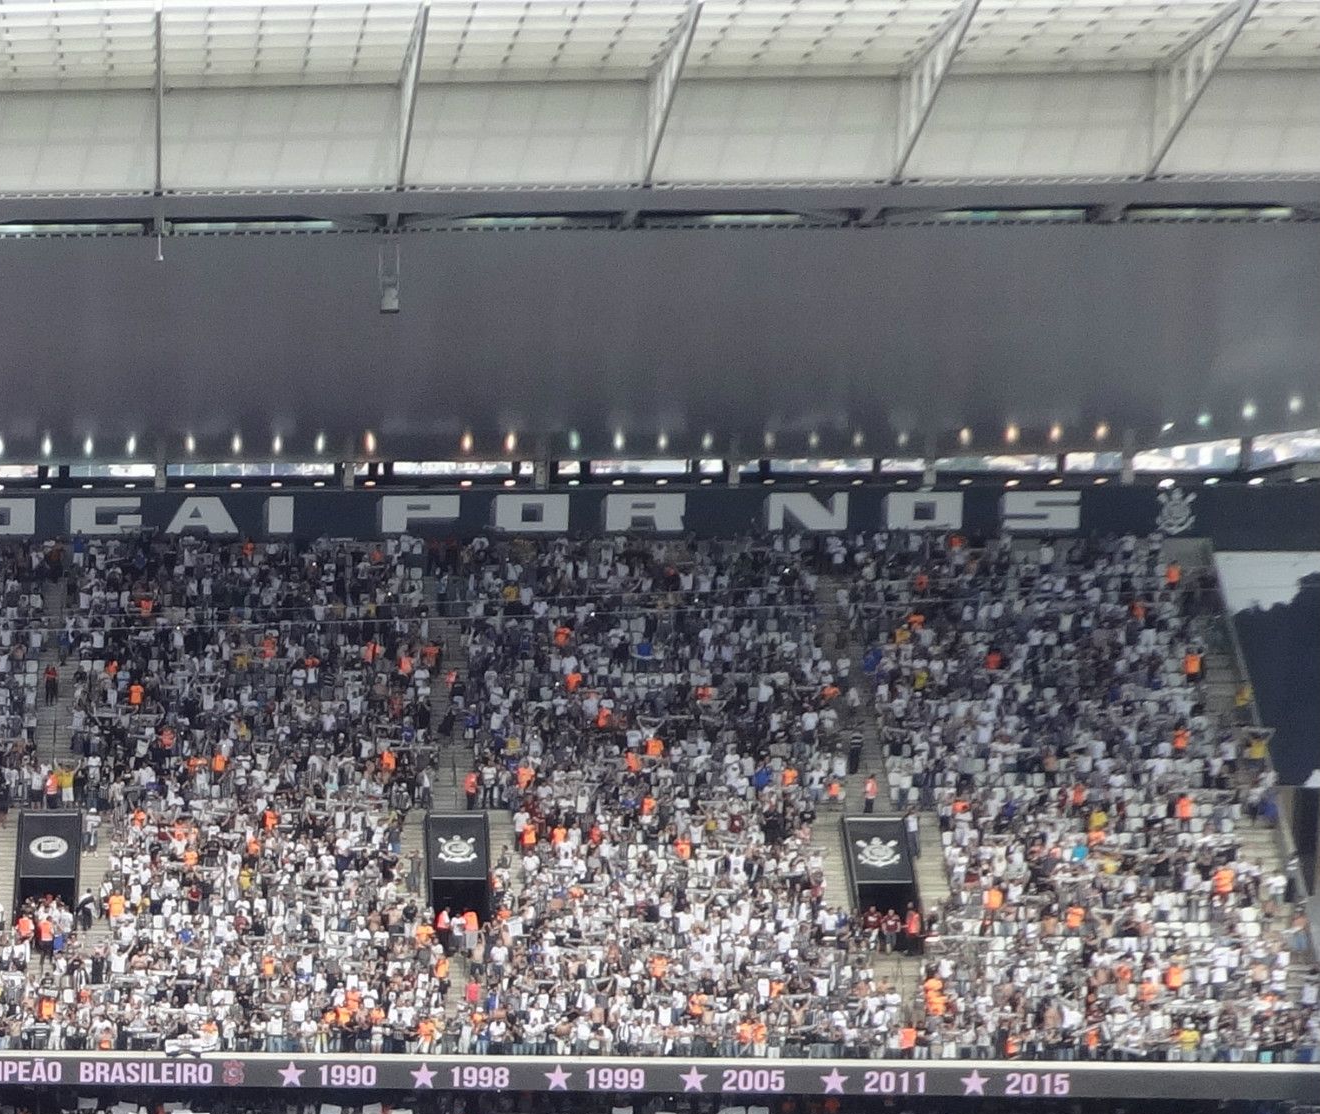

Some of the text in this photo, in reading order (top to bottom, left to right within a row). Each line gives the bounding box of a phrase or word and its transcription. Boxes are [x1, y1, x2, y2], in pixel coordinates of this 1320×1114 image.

[379, 494, 686, 533] POR
[79, 1060, 213, 1084] BRASILEIRO
[318, 1064, 377, 1087] 1990
[450, 1065, 510, 1087] 1998
[585, 1067, 645, 1089] 1999
[722, 1069, 785, 1091] 2005
[864, 1070, 927, 1093] 2011
[1005, 1072, 1070, 1095] 2015
